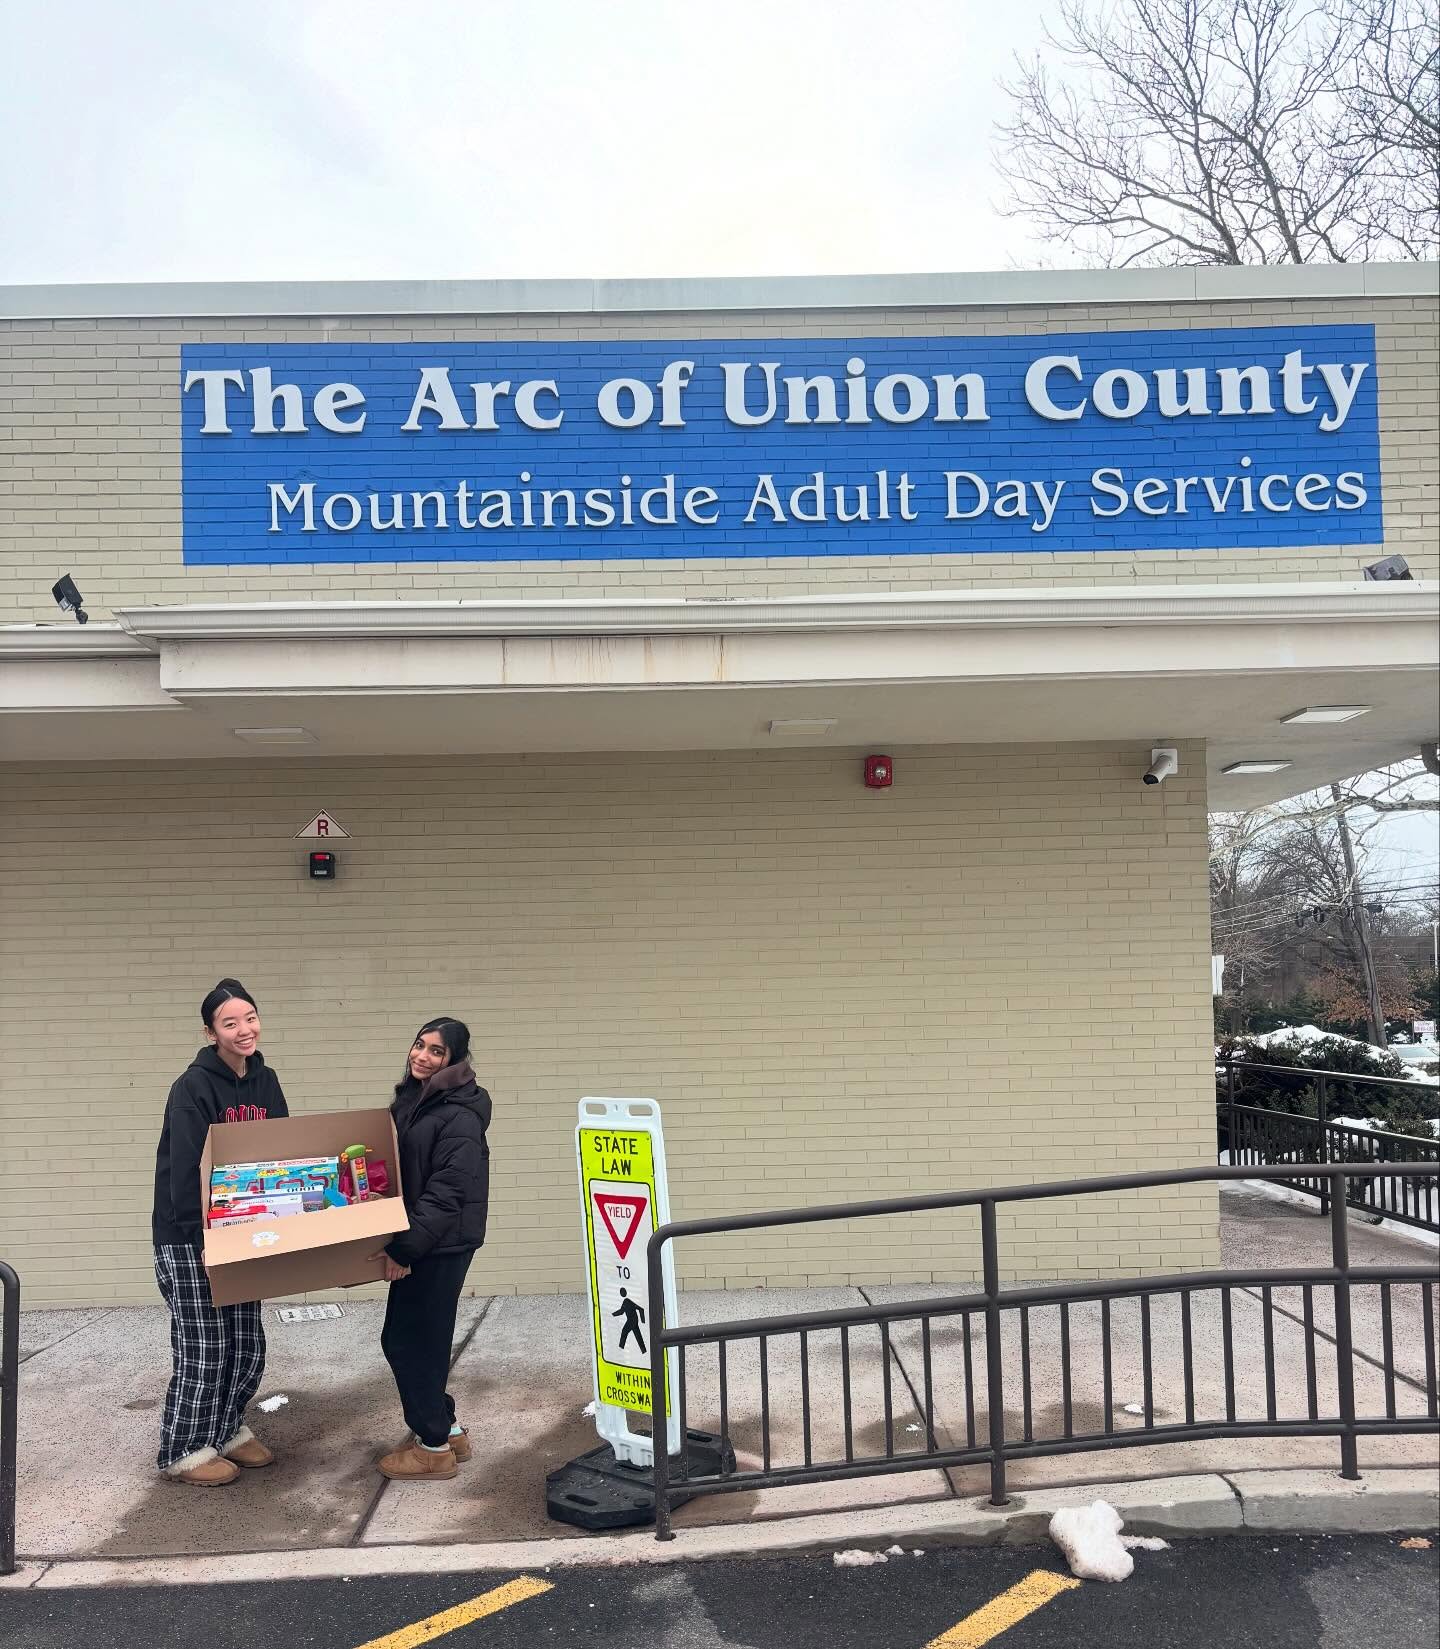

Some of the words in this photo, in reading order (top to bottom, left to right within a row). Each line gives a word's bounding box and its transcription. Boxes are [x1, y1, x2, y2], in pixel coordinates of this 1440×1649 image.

[184, 367, 366, 433] The
[401, 368, 563, 430] Arc
[598, 361, 694, 426] of
[720, 358, 990, 425] Union
[1025, 350, 1368, 431] County
[268, 472, 718, 530] Mountainside
[744, 471, 917, 521] Adult
[945, 472, 1065, 531] Day
[1091, 457, 1366, 515] Services
[317, 819, 329, 836] R
[593, 1135, 639, 1155] STATE
[601, 1157, 632, 1176] LAW
[607, 1205, 632, 1219] YIELD
[616, 1265, 631, 1280] TO
[615, 1370, 651, 1389] WITHIN
[606, 1385, 651, 1407] CROSSWA
